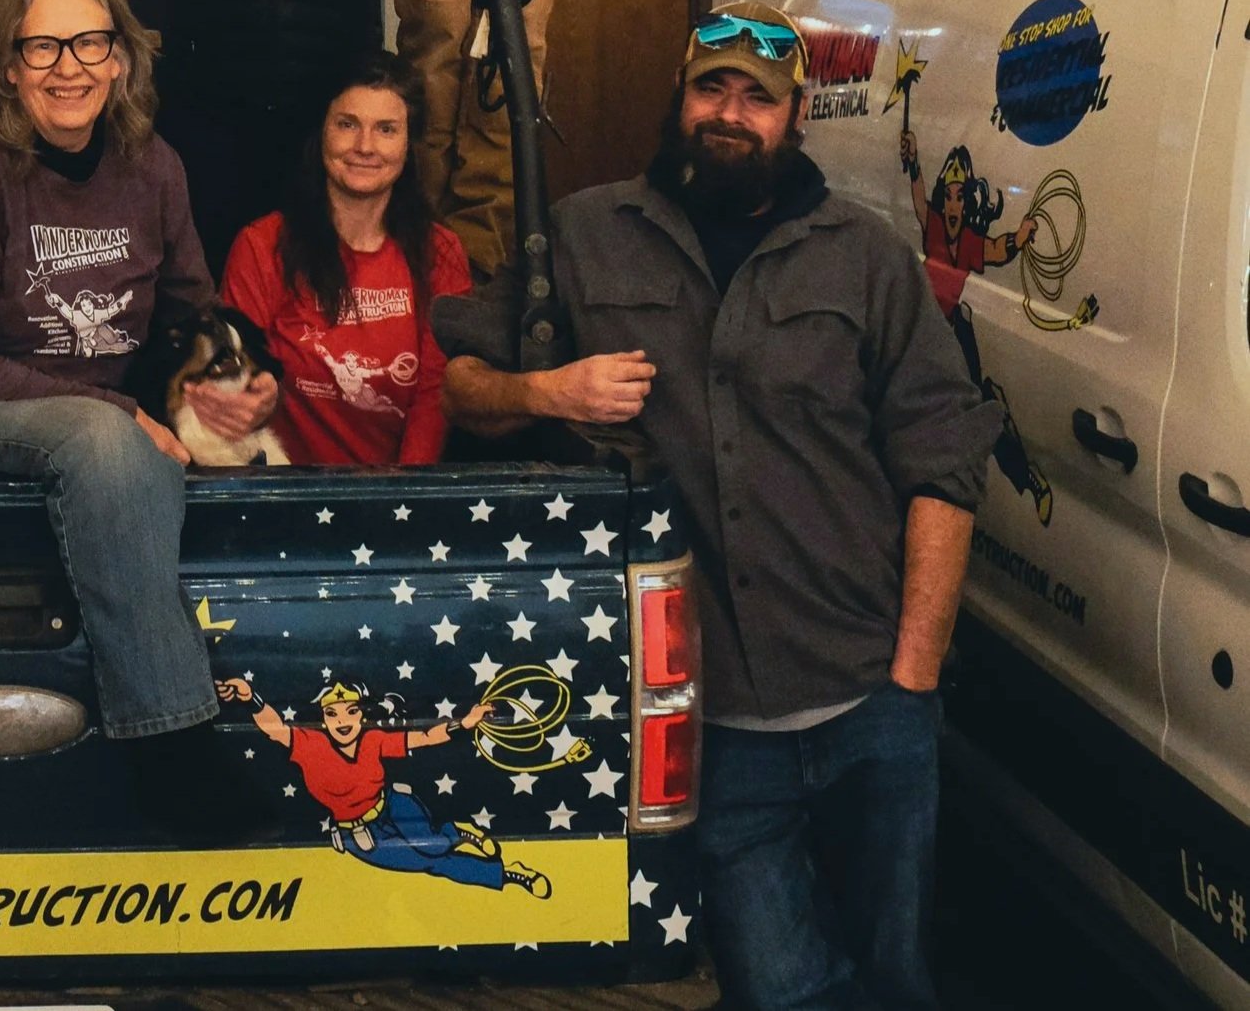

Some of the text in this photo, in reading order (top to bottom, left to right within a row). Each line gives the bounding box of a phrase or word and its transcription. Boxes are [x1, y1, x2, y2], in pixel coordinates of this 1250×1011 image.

[1018, 21, 1045, 46] STOP
[1045, 12, 1072, 38] SHOP
[811, 88, 869, 121] ELECTRICAL
[30, 224, 130, 263] WONDERWOMAN
[1180, 848, 1248, 944] Lic #
